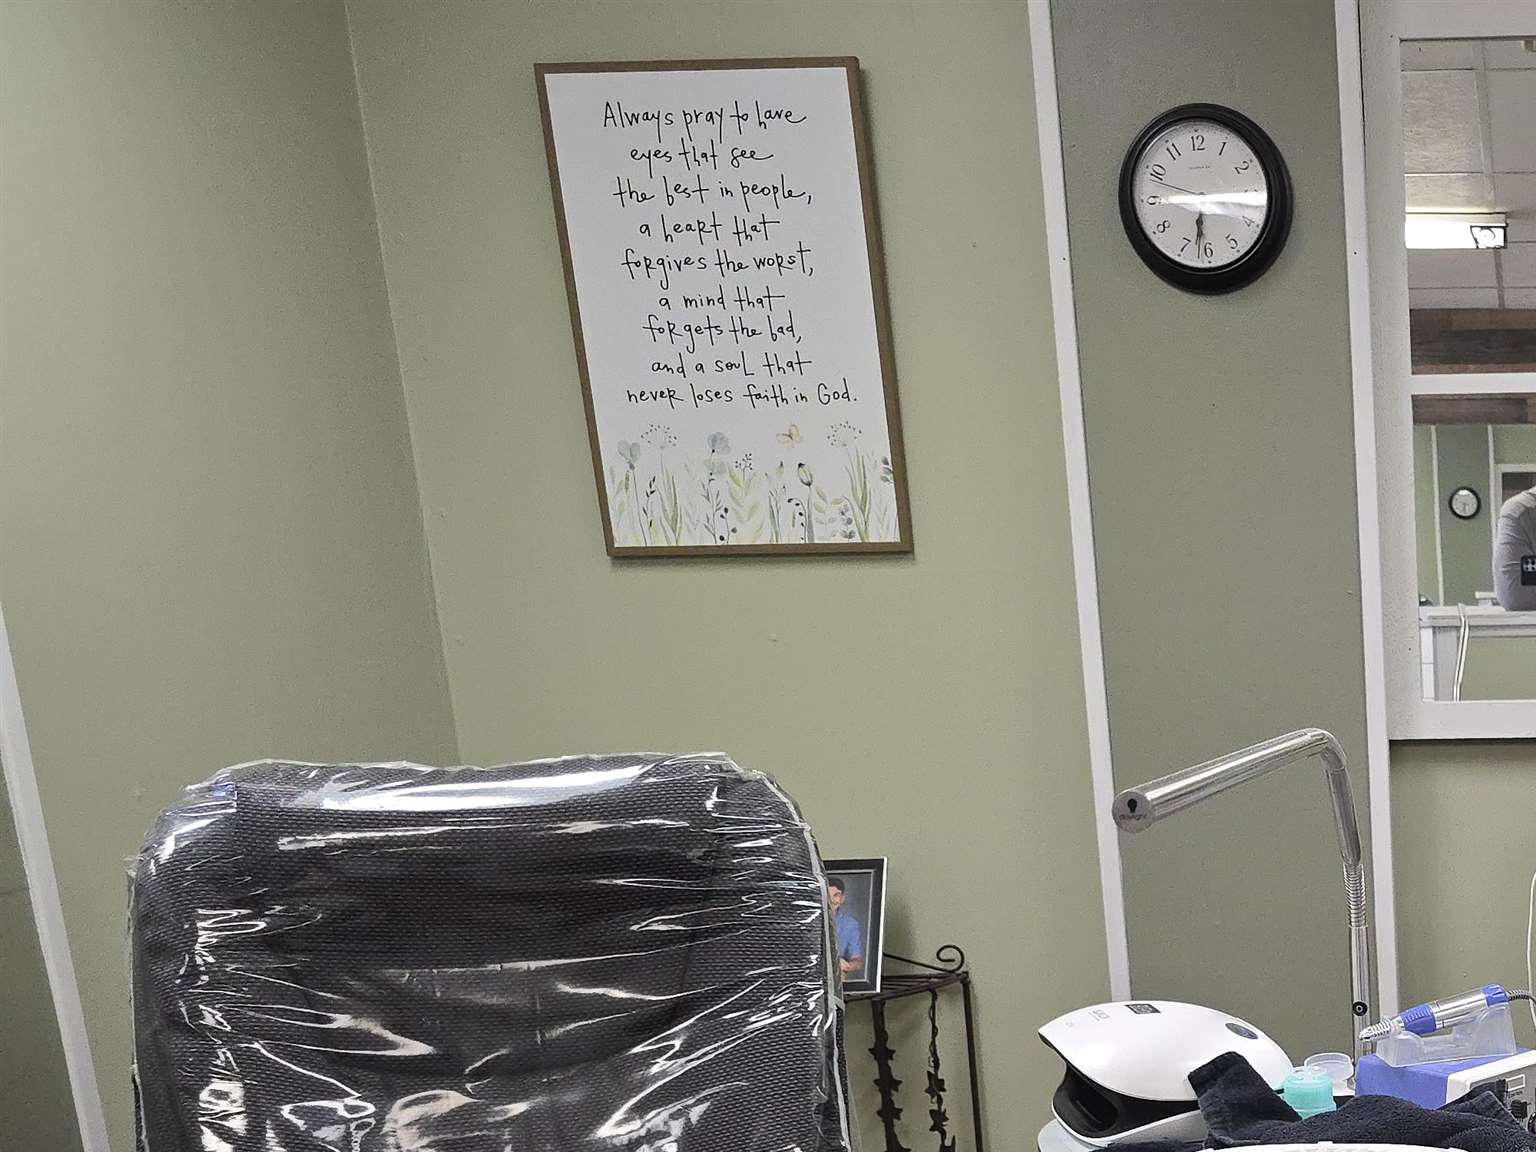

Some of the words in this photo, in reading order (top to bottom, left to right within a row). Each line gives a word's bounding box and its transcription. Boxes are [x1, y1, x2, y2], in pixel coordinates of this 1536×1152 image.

[604, 101, 673, 143] Always
[682, 108, 723, 144] pray
[729, 100, 748, 135] to
[755, 100, 807, 129] have
[1166, 143, 1181, 160] 11
[1191, 135, 1205, 151] 12
[1218, 141, 1226, 156] 1
[631, 149, 672, 179] eyes
[678, 137, 718, 171] that
[731, 147, 774, 168] see
[1234, 160, 1249, 174] 2
[1150, 163, 1166, 181] 10
[613, 176, 655, 208] the
[663, 174, 709, 206] best
[718, 181, 733, 197] in
[740, 174, 811, 212] people,
[640, 224, 651, 237] a
[661, 211, 722, 245] heart
[732, 213, 780, 247] that
[1156, 220, 1171, 234] 8
[1180, 237, 1191, 253] 7
[1204, 242, 1213, 258] 6
[1225, 233, 1238, 249] 5
[621, 248, 707, 290] forgives
[714, 248, 749, 278] the
[753, 241, 813, 277] worst,
[659, 298, 671, 310] a
[683, 284, 726, 310] mind
[733, 286, 785, 312] that
[642, 314, 723, 354] forgets
[729, 316, 762, 344] the
[767, 310, 801, 343] bad,
[652, 352, 686, 378] and
[695, 363, 704, 374] a
[715, 351, 755, 376] soul
[762, 350, 812, 377] that
[627, 388, 684, 409] never
[690, 383, 733, 408] loses
[743, 384, 788, 408] faith
[793, 387, 808, 403] in
[818, 378, 857, 405] God.
